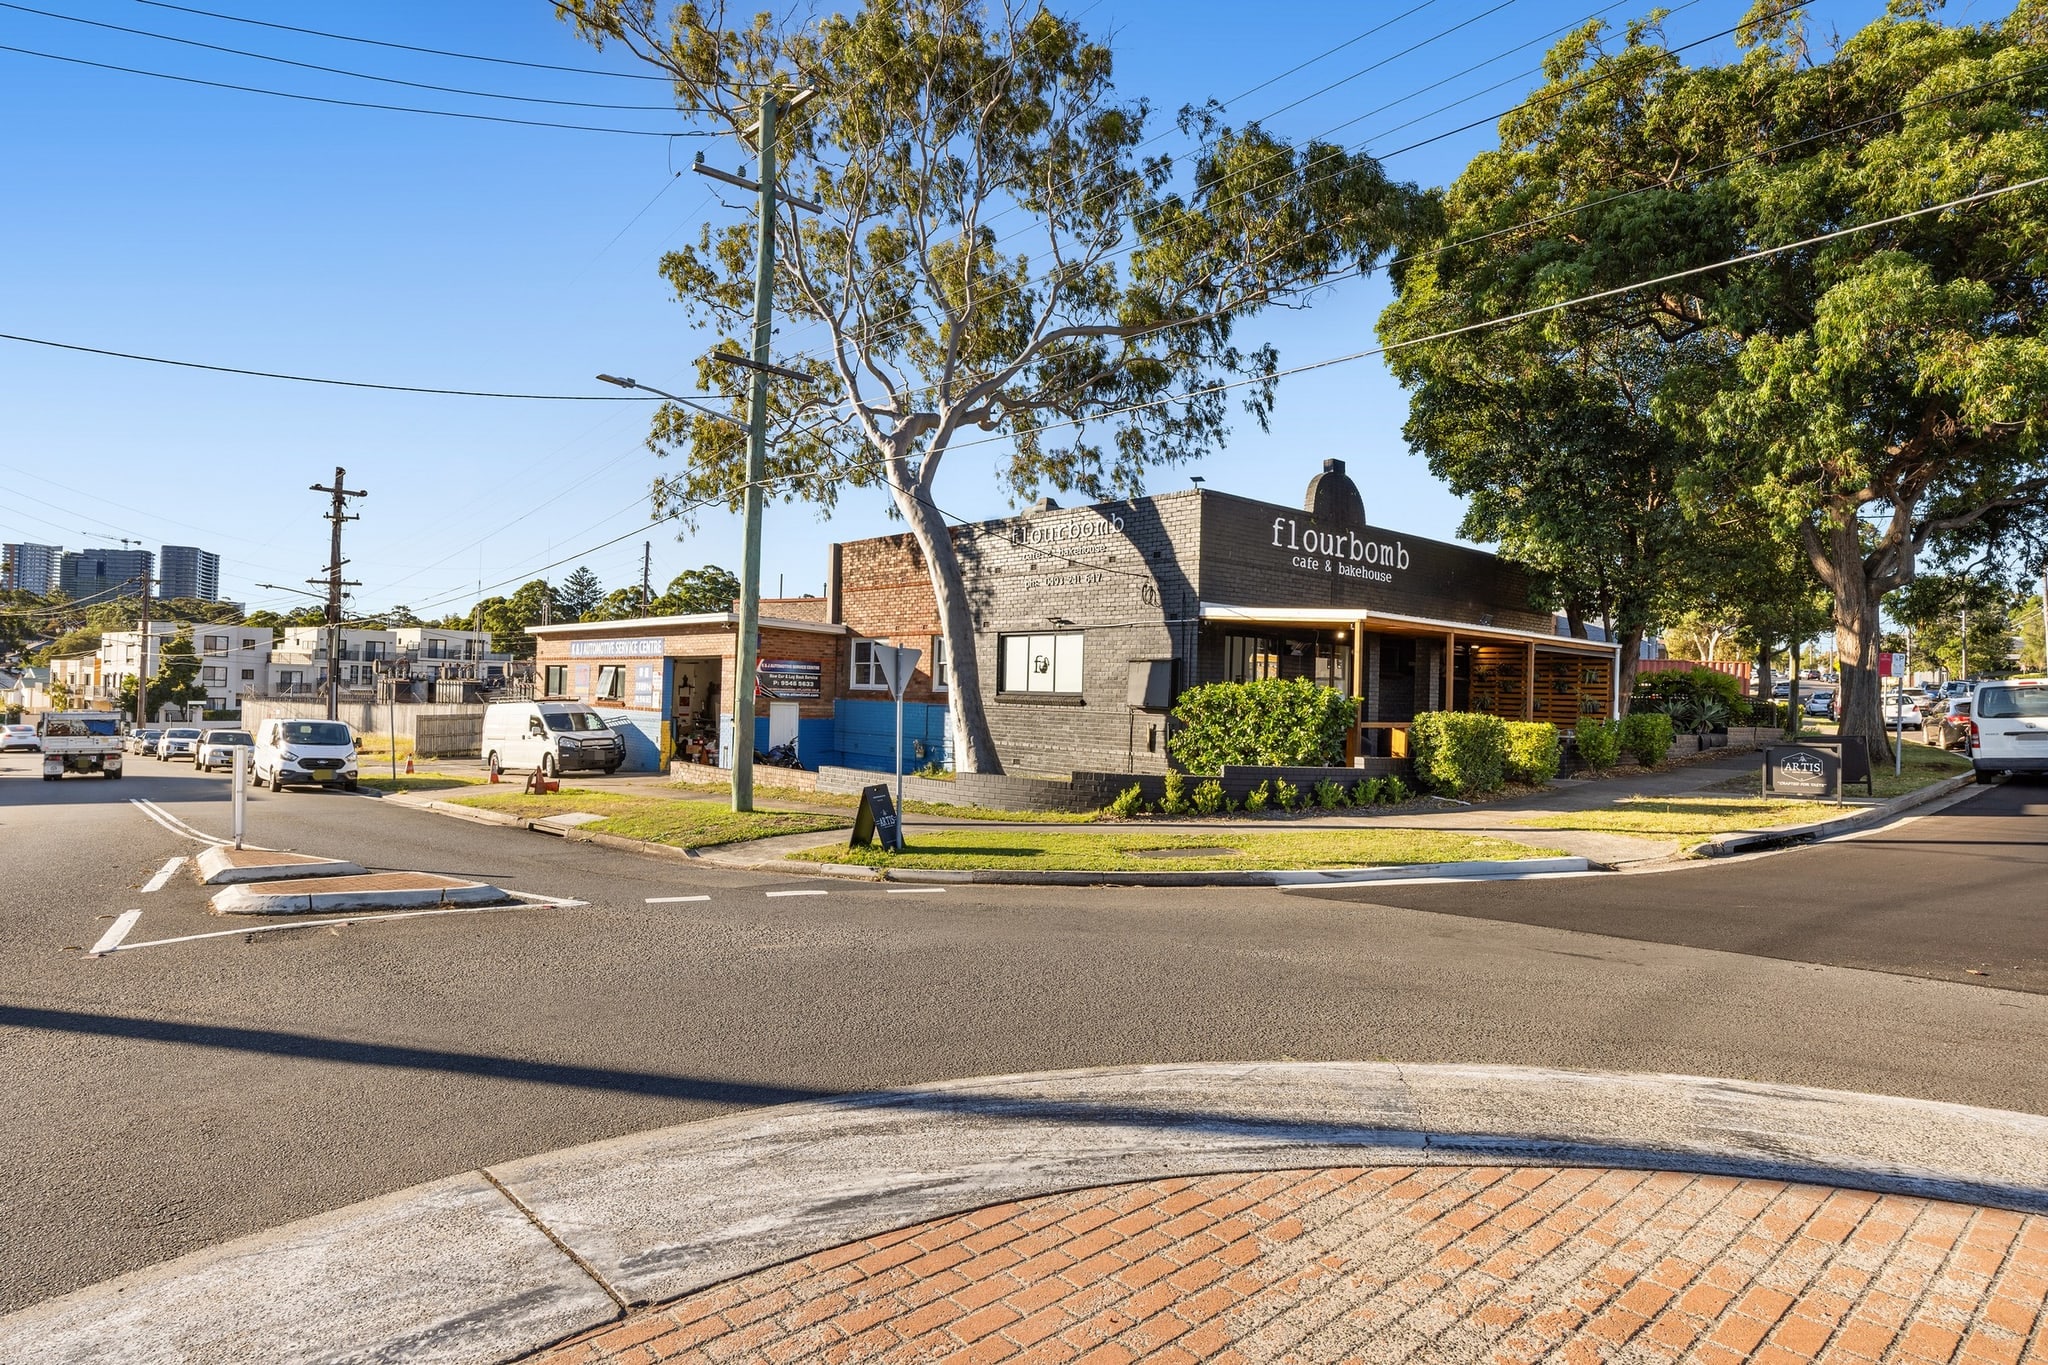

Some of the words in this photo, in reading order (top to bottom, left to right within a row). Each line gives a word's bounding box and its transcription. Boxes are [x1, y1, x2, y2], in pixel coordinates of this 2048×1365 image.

[1011, 512, 1125, 546] flourbomb
[1022, 551, 1041, 560] cafe
[1058, 543, 1107, 557] bakehouse
[1271, 517, 1410, 570] flourbomb
[1292, 556, 1319, 570] cafe
[1324, 559, 1332, 572] &
[1338, 561, 1393, 583] bakehouse
[583, 641, 615, 655] AUTOMOTIVE
[615, 640, 638, 655] SERVICE
[638, 640, 662, 654] CENTRE
[1784, 762, 1821, 772] ARTIS
